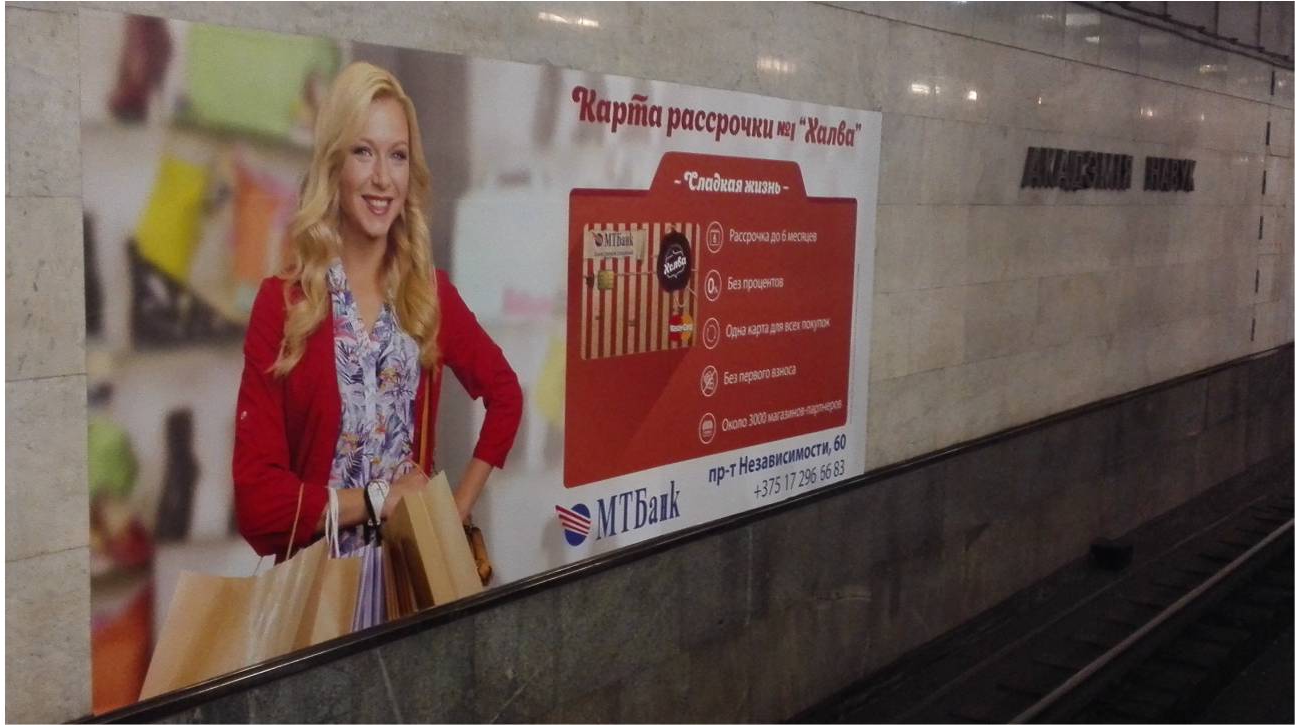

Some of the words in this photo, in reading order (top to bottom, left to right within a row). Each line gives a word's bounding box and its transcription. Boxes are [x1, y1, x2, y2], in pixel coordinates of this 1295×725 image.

[572, 85, 663, 133] Карта
[666, 106, 774, 142] рассрочки
[777, 120, 796, 141] №1
[684, 171, 743, 194] Сладкая
[744, 178, 781, 195] жизнь
[729, 228, 769, 245] Рассрочка
[770, 232, 780, 244] до
[781, 229, 787, 242] 6
[788, 231, 817, 244] месяцев
[727, 276, 742, 290] Без
[743, 277, 784, 292] процентов
[726, 324, 746, 339] Одна
[748, 325, 769, 338] карта
[770, 323, 783, 335] для
[784, 321, 800, 333] всех
[802, 318, 831, 332] покупок
[723, 371, 737, 385] Без
[739, 369, 770, 385] первого
[771, 365, 796, 378] взноса
[722, 417, 747, 432] Около
[749, 411, 767, 427] 3000
[708, 463, 737, 486] пр-т
[739, 441, 831, 475] Независимости,
[834, 434, 847, 451] 60
[754, 477, 781, 498] +375
[784, 473, 796, 492] 17
[798, 468, 817, 488] 296
[820, 464, 832, 481] 66
[834, 460, 845, 477] 83
